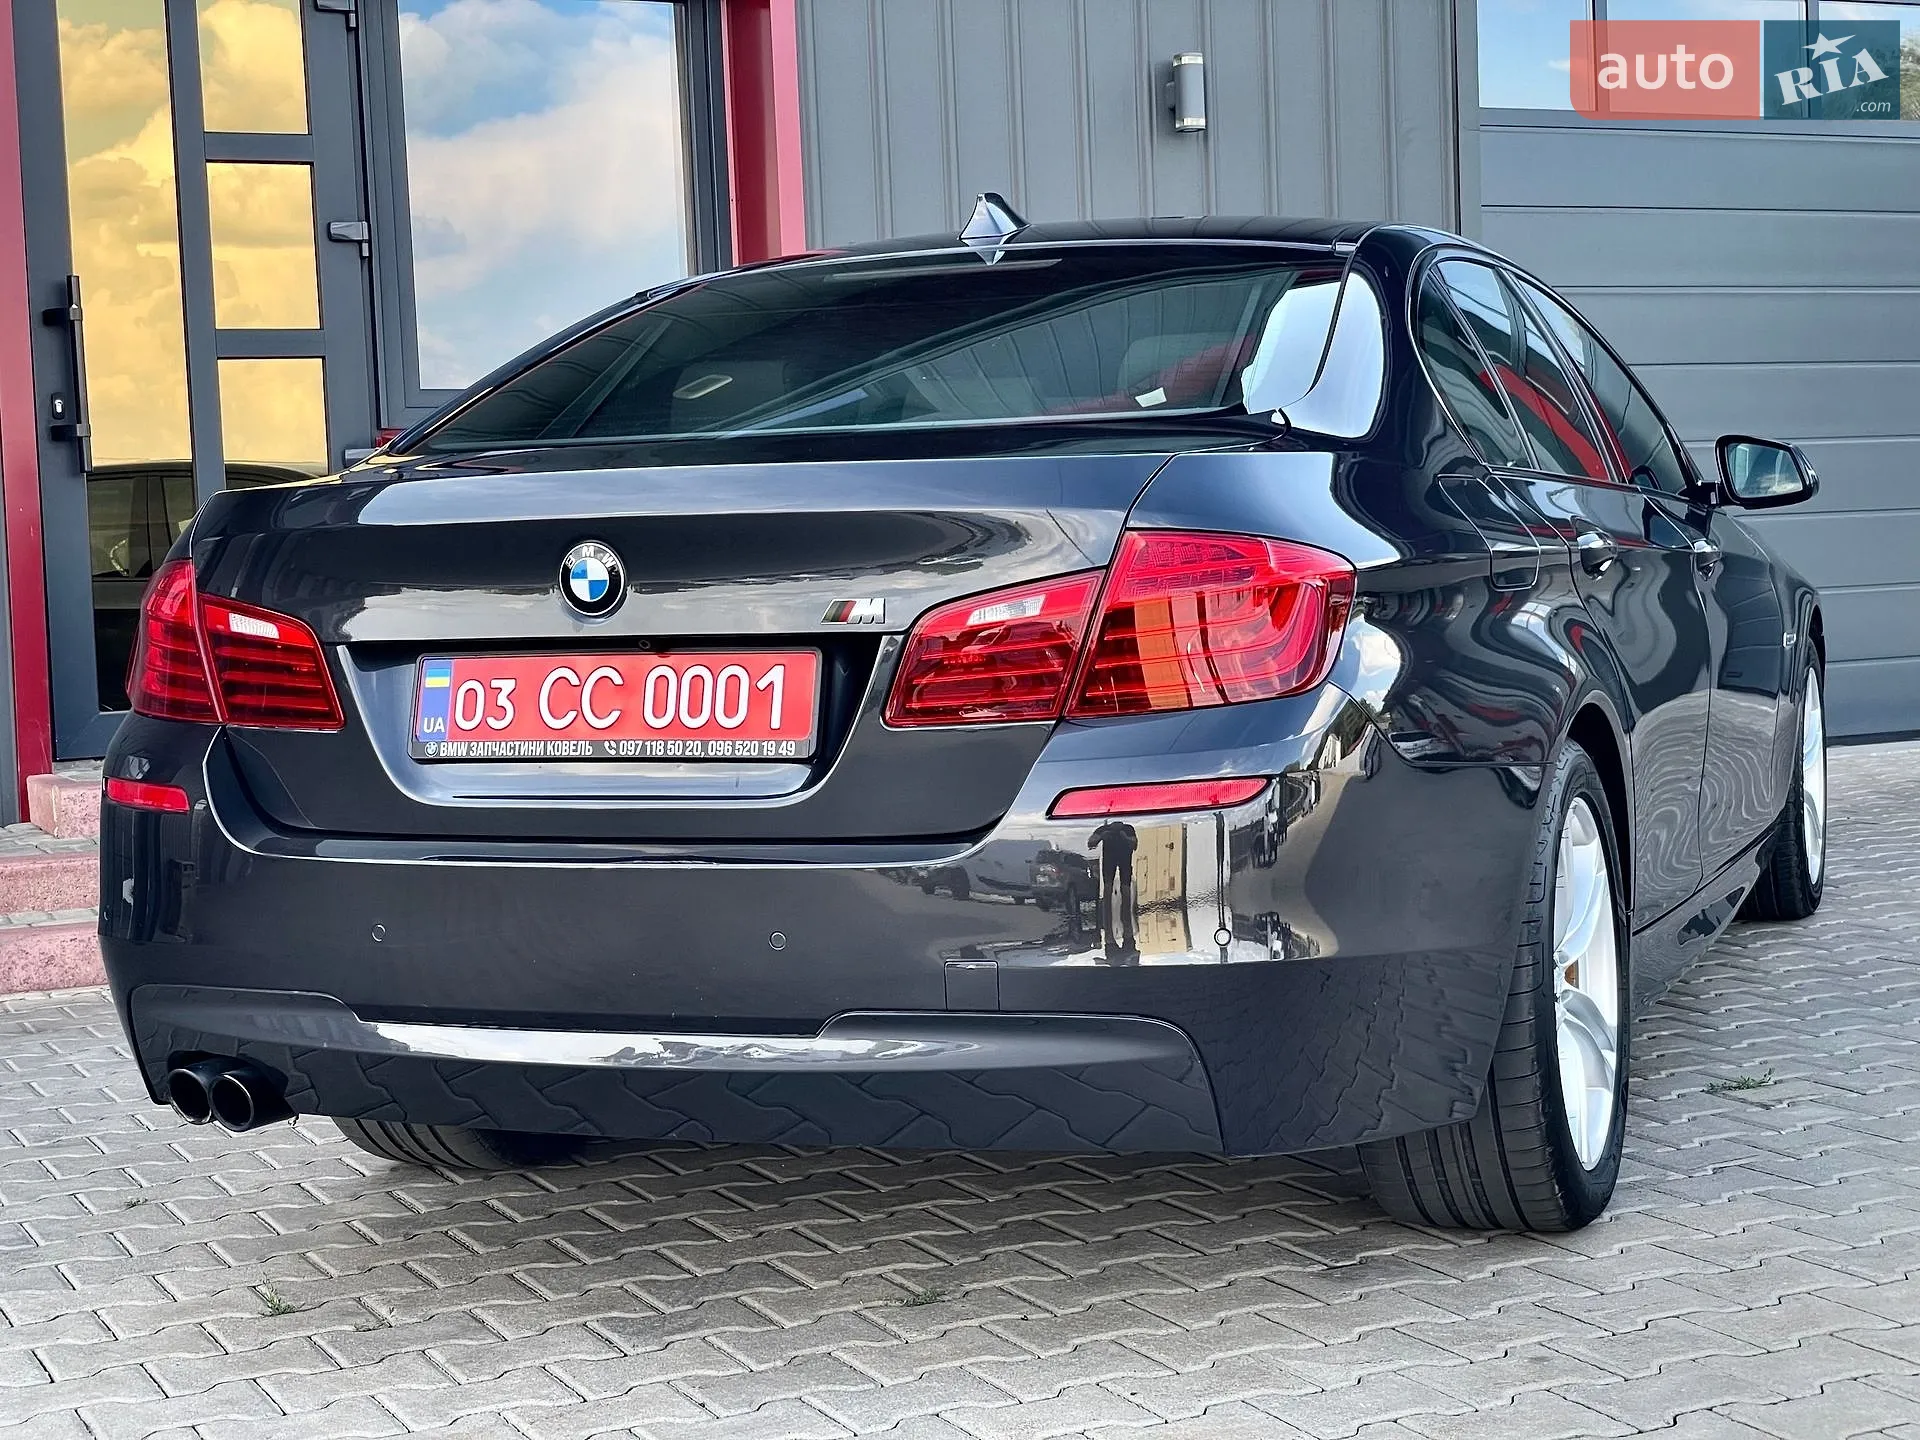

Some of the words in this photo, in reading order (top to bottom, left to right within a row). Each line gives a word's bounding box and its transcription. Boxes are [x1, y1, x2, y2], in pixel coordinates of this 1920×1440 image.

[564, 545, 617, 570] BMW
[454, 678, 517, 731] 03
[538, 665, 624, 730] CC
[642, 664, 786, 730] 0001
[423, 717, 446, 734] UA
[439, 742, 468, 757] BMW
[469, 741, 545, 757] ЗАПЧАСТИНИ
[546, 740, 593, 756] КОВЕЛЬ
[619, 740, 643, 756] 097
[644, 740, 664, 756] 118
[666, 740, 683, 756] 50
[685, 740, 705, 758] 20,
[707, 740, 731, 755] 096
[734, 740, 758, 755] 520
[761, 740, 775, 755] 19
[778, 740, 796, 755] 49
